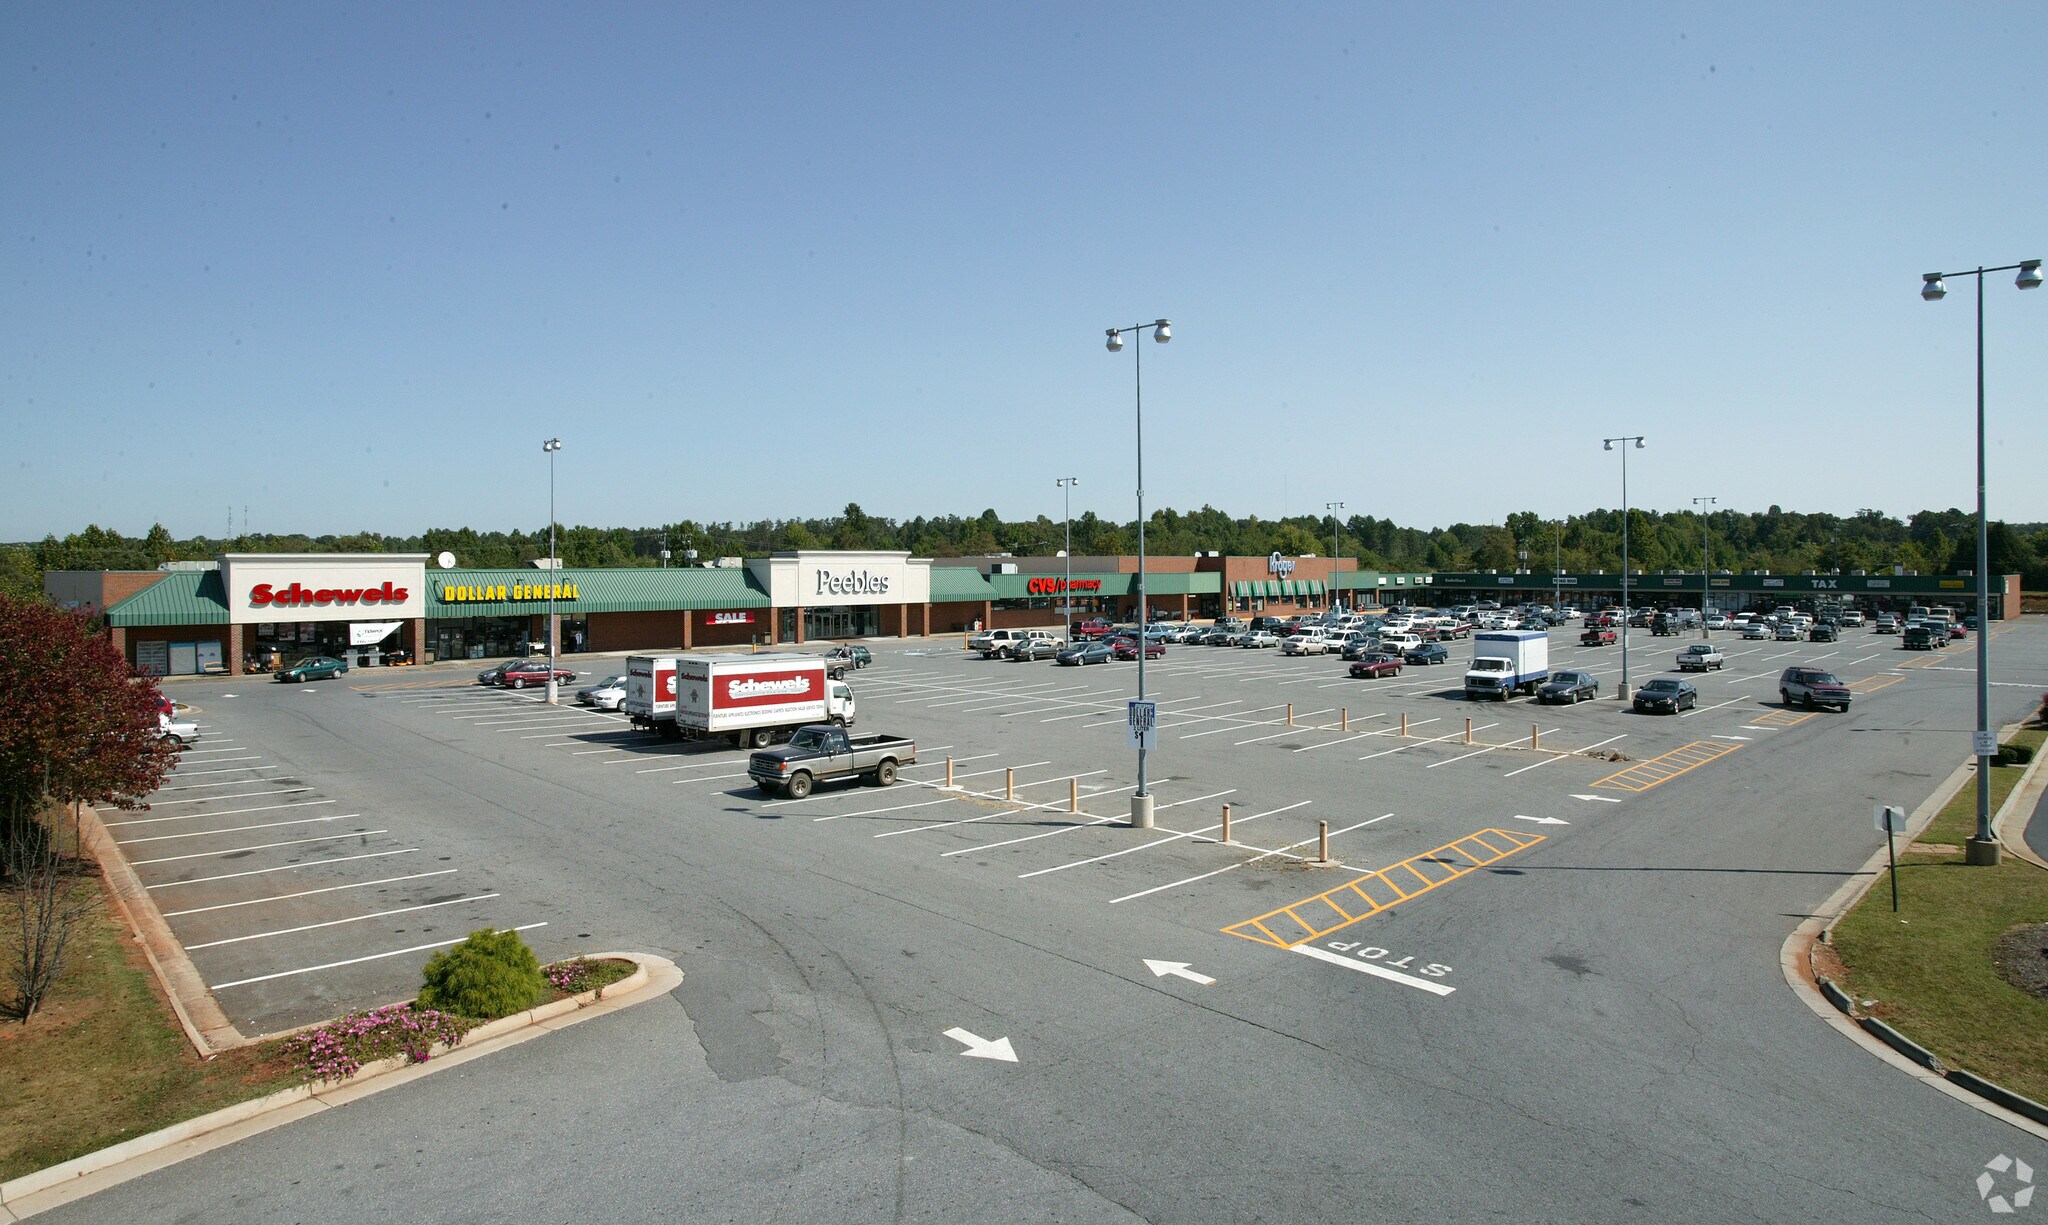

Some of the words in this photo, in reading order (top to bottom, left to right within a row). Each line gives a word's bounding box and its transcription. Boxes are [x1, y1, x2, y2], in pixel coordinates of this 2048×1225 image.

[1269, 552, 1295, 579] Kroger
[816, 569, 890, 595] Peebles
[1811, 579, 1838, 589] TAX
[251, 581, 409, 605] Schewels
[444, 585, 507, 601] DOLLAR
[513, 583, 579, 600] GENERAL
[714, 611, 747, 624] SALE
[728, 675, 810, 694] Schewels
[1129, 716, 1153, 727] GENERAL
[1134, 731, 1144, 748] $1
[1327, 940, 1453, 977] STOP
